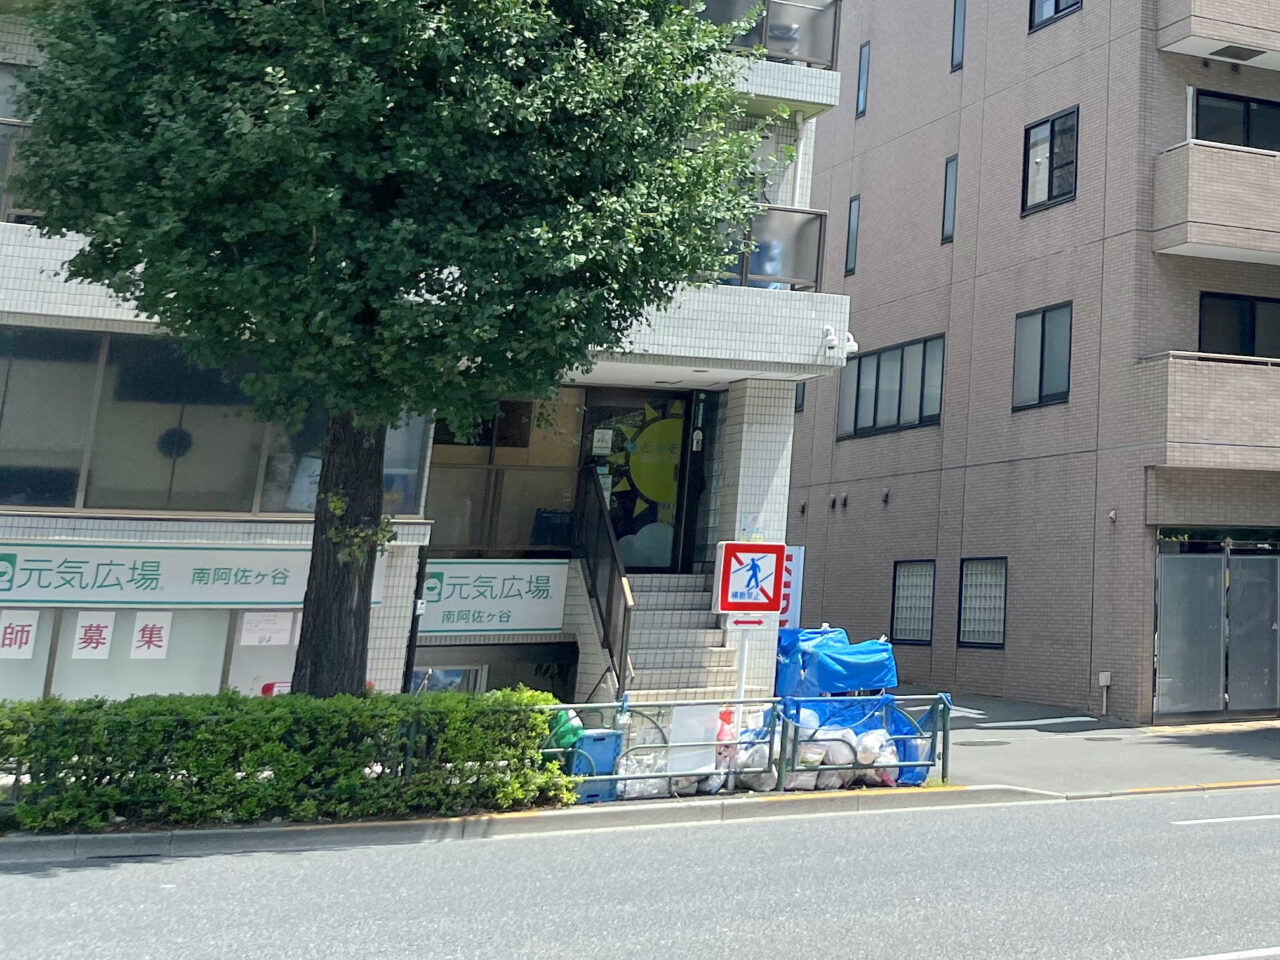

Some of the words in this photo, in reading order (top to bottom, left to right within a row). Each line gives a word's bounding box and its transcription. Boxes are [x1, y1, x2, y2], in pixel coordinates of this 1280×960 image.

[17, 558, 161, 590] 元気広場
[191, 567, 290, 586] 南阿佐ヶ谷
[444, 574, 551, 600] 元気広場
[441, 610, 512, 624] 南阿佐ヶ谷
